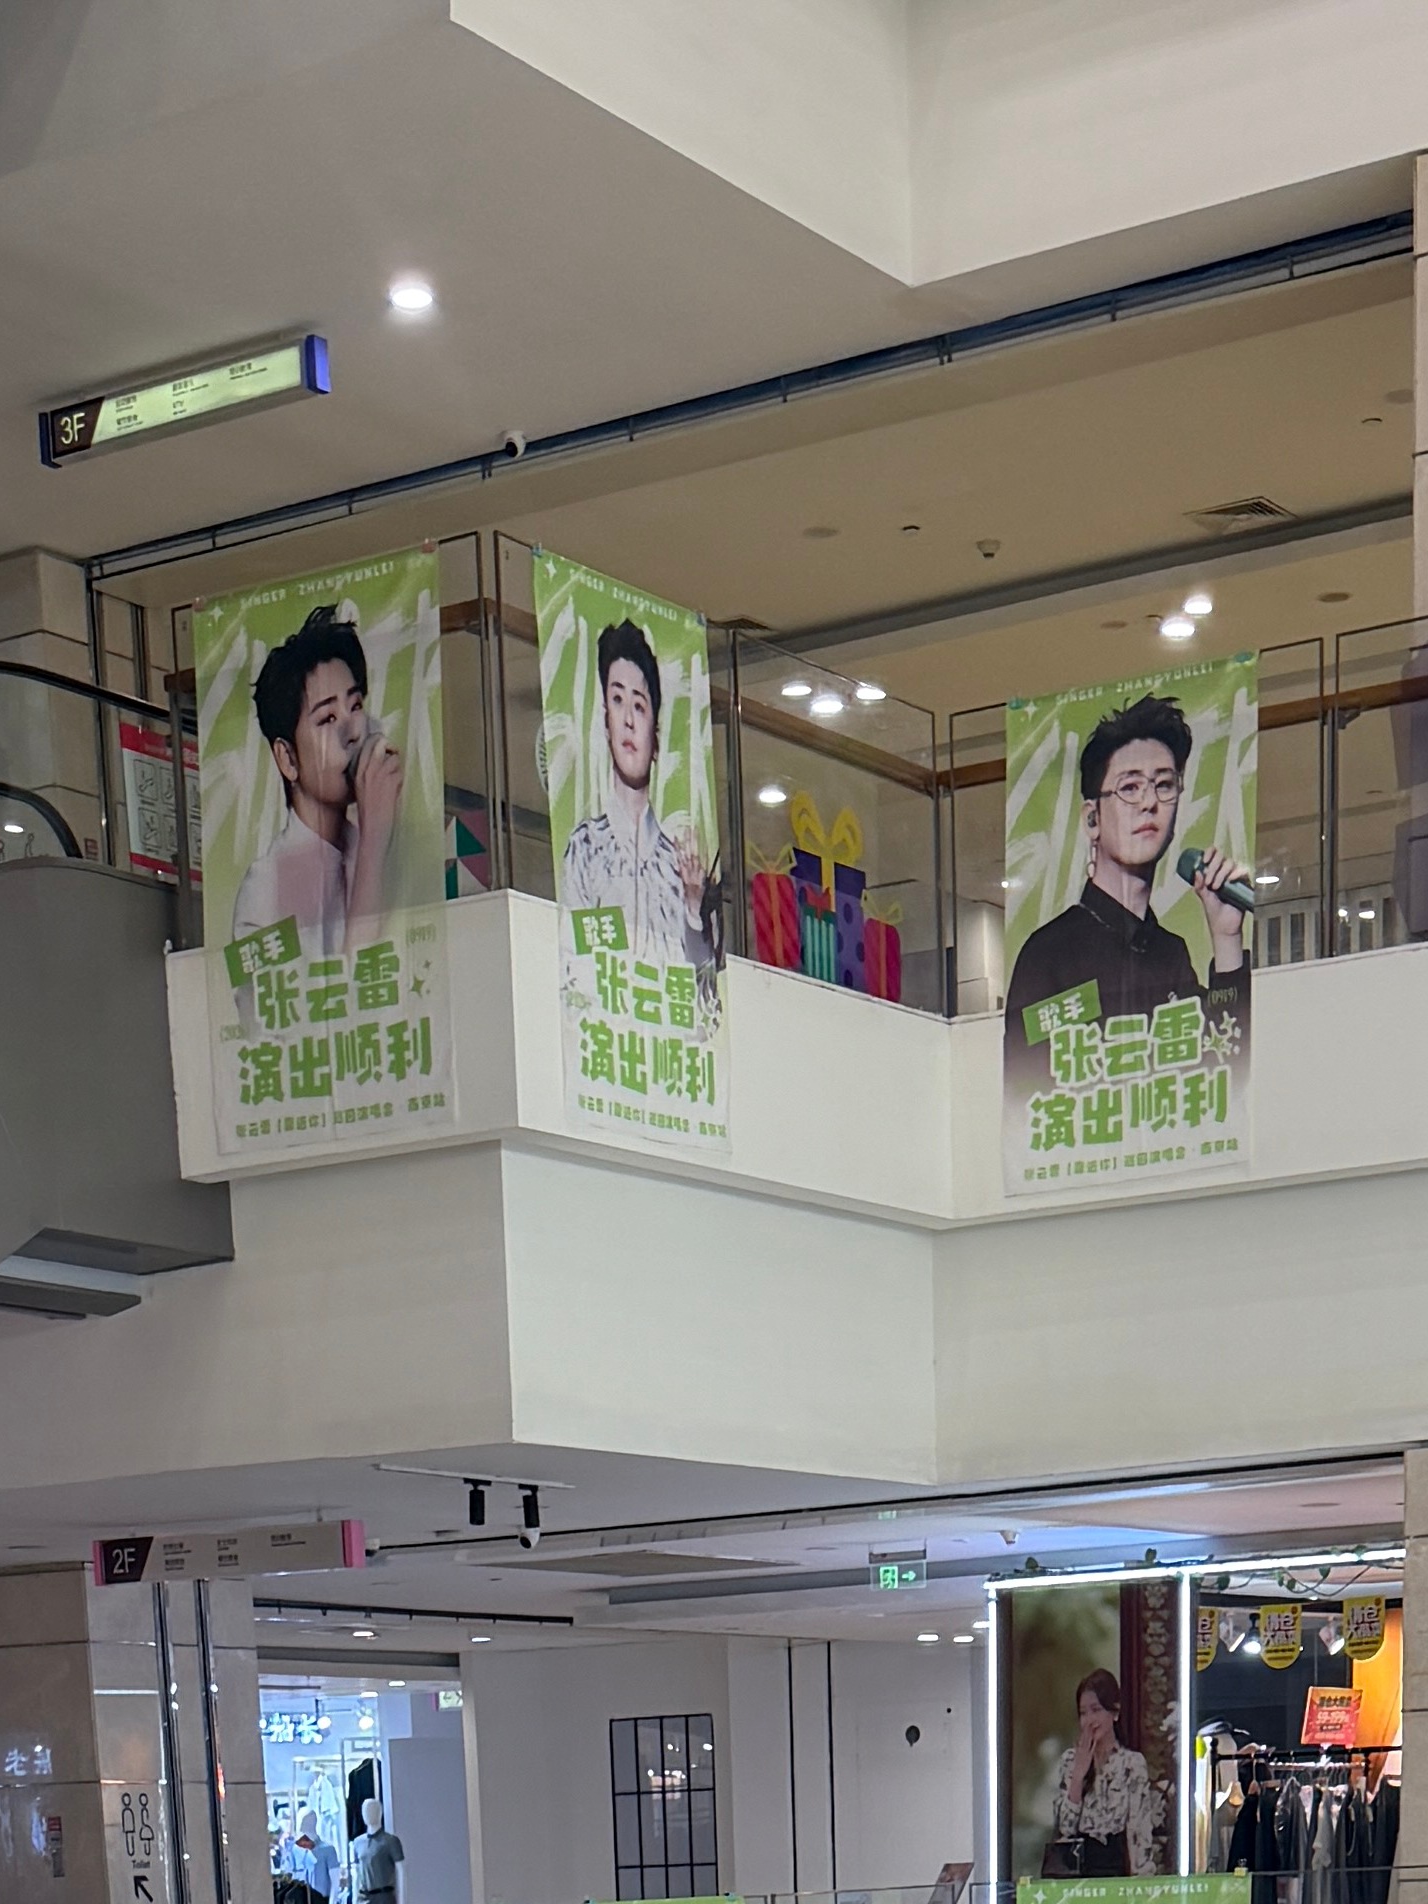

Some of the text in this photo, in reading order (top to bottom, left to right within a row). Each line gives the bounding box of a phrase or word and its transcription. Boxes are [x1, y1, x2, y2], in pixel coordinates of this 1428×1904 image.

[59, 411, 86, 445] 3F
[239, 928, 287, 974] 歌手
[581, 914, 618, 947] 歌手
[256, 940, 400, 1030] 张云雷
[594, 951, 697, 1030] 张云雷
[1037, 991, 1086, 1033] 歌手
[237, 1016, 434, 1106] 演出顺利
[579, 1017, 715, 1107] 演出顺利
[1053, 1001, 1201, 1084] 张云雷
[1030, 1068, 1229, 1151] 演出顺利
[111, 1548, 137, 1575] 2F
